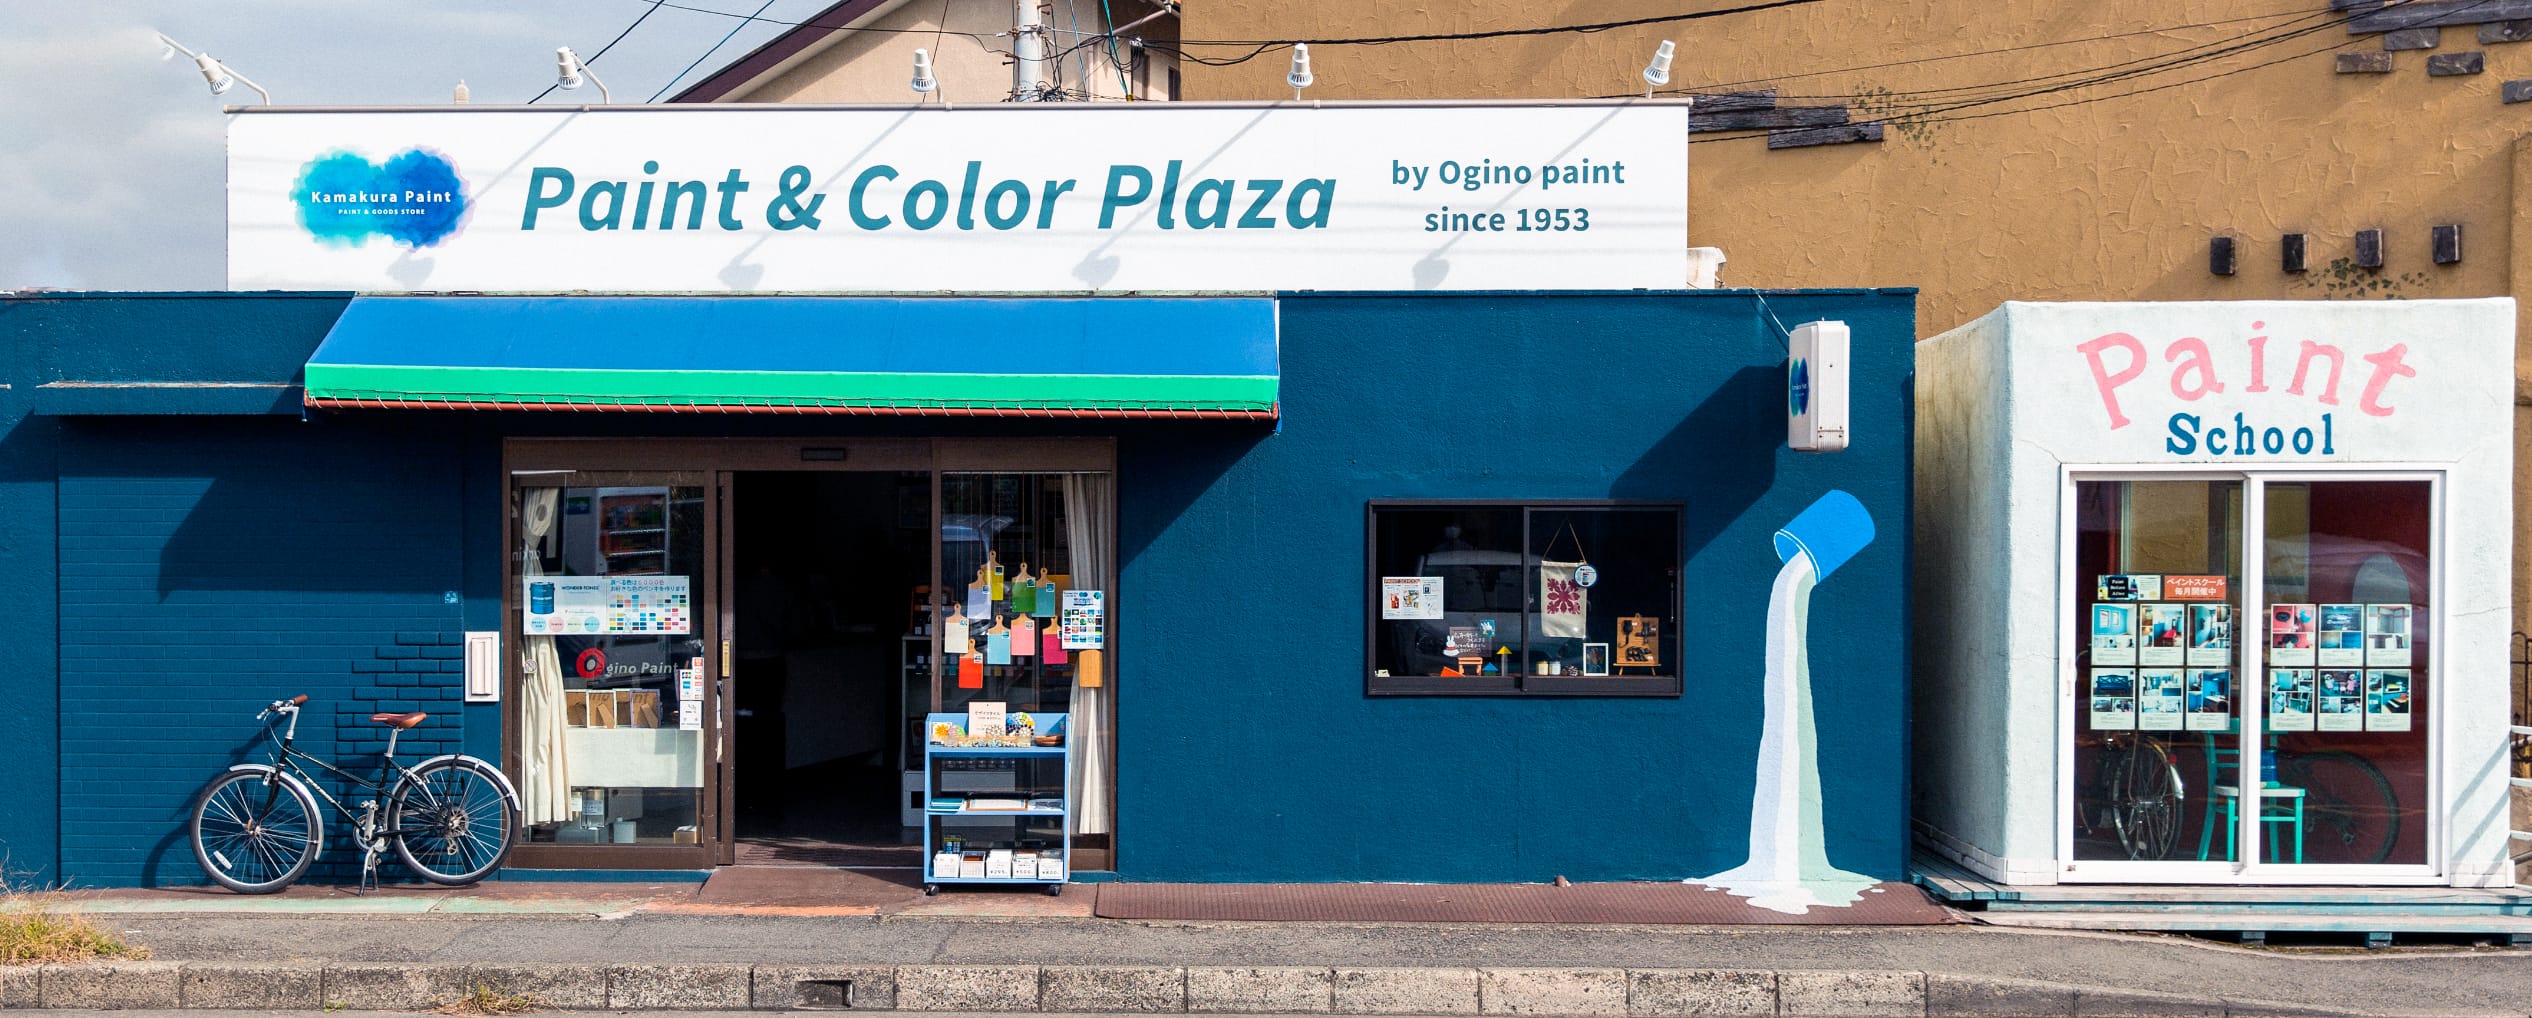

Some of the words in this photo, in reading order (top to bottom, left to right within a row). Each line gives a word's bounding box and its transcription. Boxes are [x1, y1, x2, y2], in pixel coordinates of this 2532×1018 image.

[1392, 159, 1429, 191] by
[1439, 158, 1532, 191] Ogino
[1542, 158, 1625, 190] paint
[311, 190, 398, 203] Kamakura
[405, 190, 451, 203] Paint
[521, 160, 749, 232] Paint
[766, 164, 826, 231] &
[848, 161, 1076, 231] Color
[1098, 159, 1336, 230] Plaza
[1425, 206, 1505, 232] since
[1516, 207, 1590, 232] 1953
[2076, 320, 2417, 431] Paint
[2165, 411, 2335, 456] School
[2166, 578, 2225, 586] ペイントスクール
[641, 661, 679, 675] Paint
